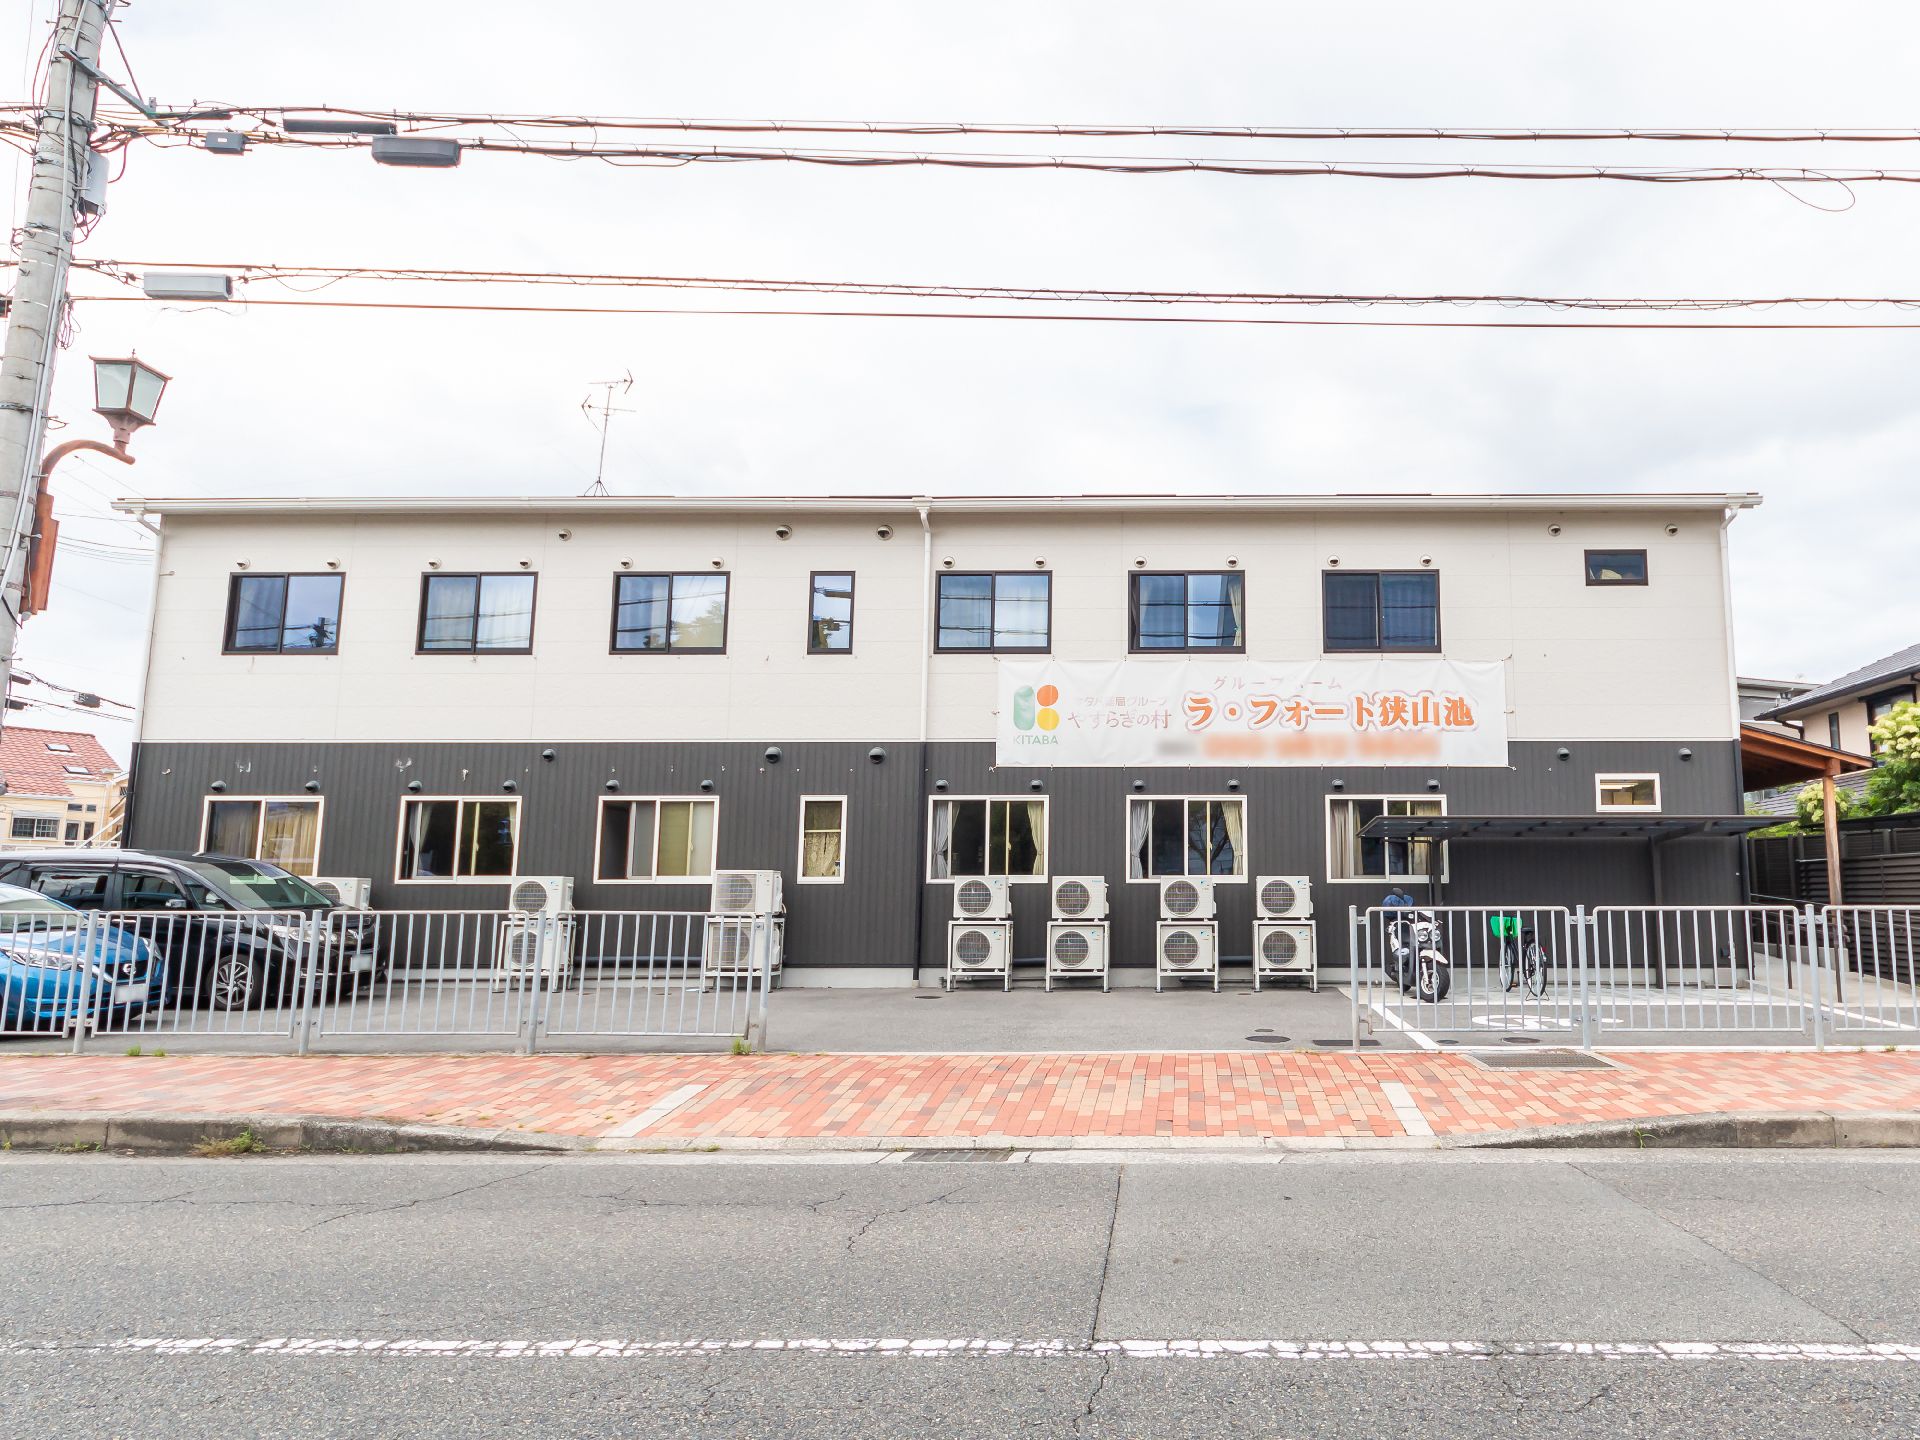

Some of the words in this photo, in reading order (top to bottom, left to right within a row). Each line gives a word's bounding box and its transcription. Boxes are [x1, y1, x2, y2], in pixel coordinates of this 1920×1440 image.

[1213, 675, 1342, 690] グルーーム
[1185, 693, 1477, 729] ラ・フォート狭山池
[1012, 734, 1059, 745] KITABA
